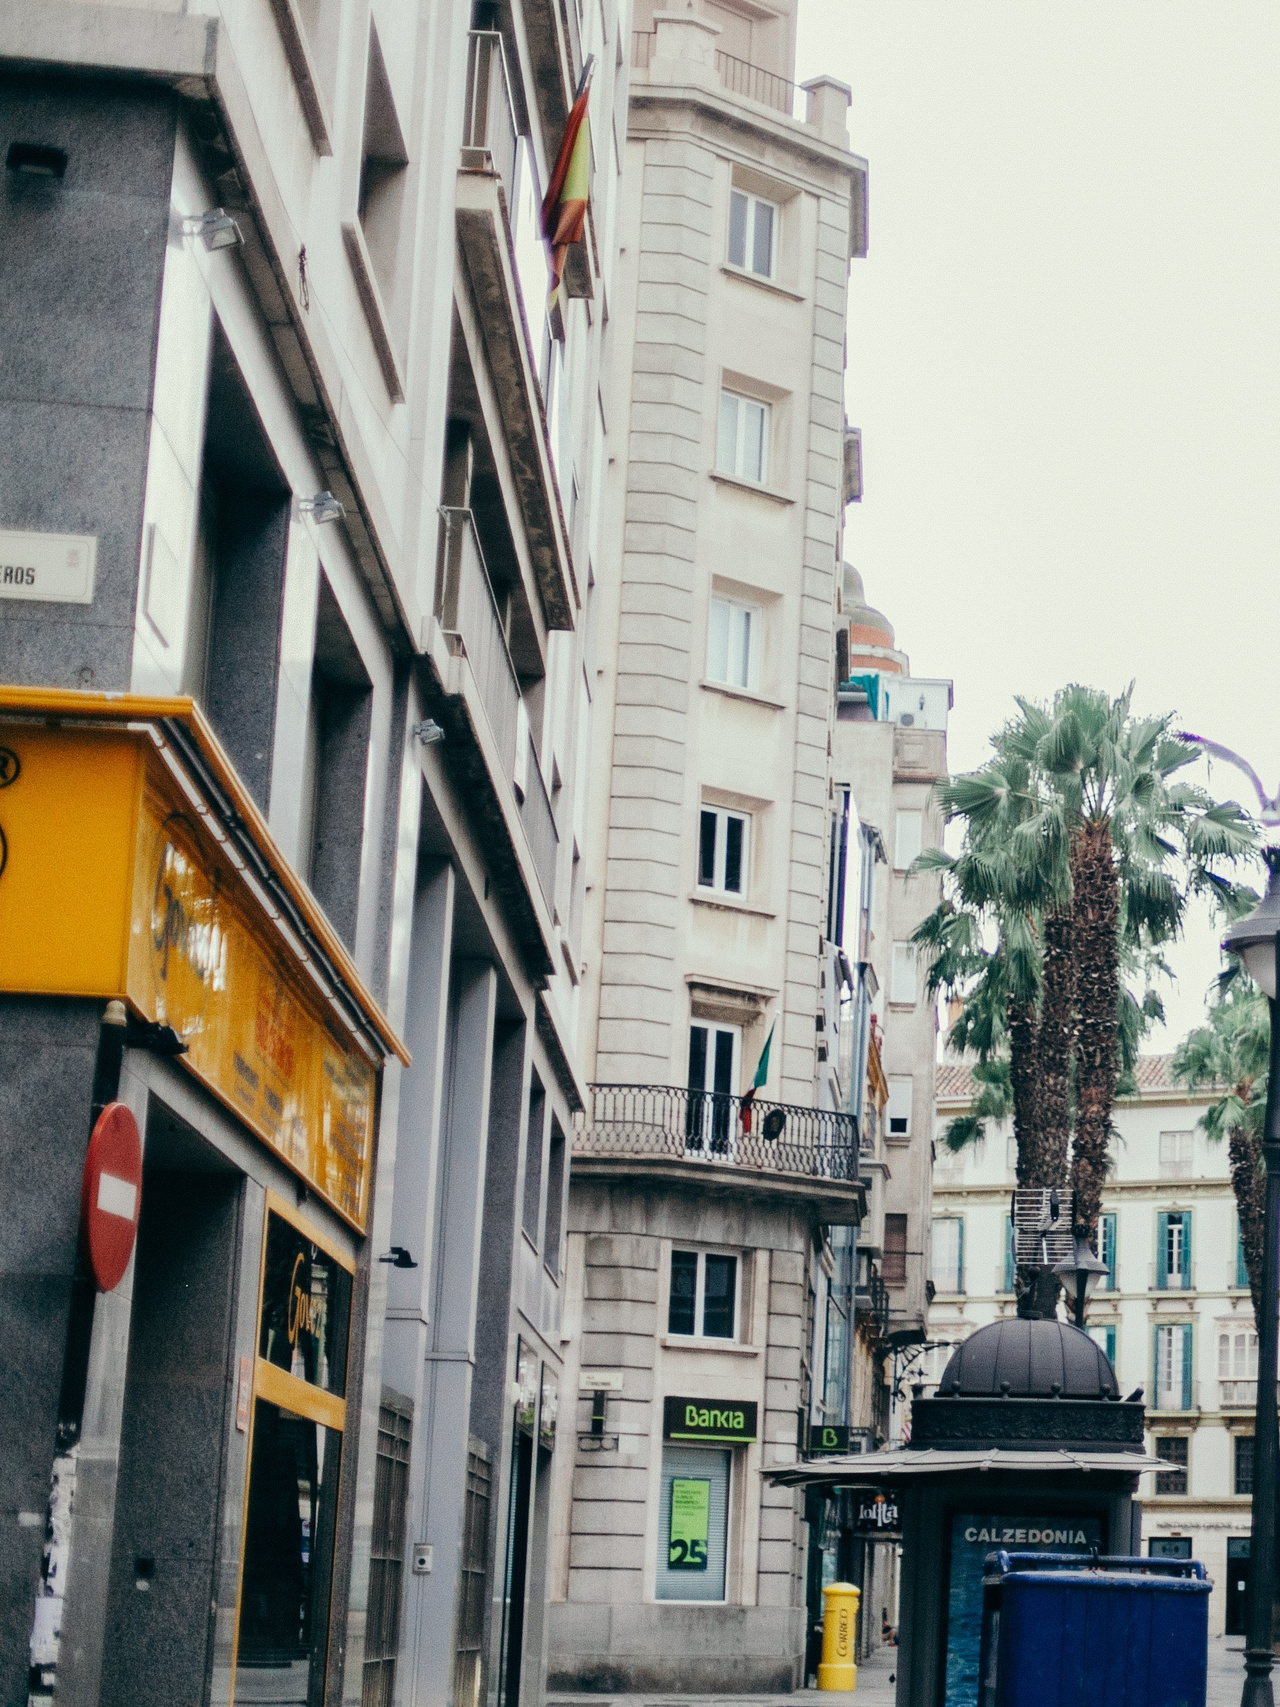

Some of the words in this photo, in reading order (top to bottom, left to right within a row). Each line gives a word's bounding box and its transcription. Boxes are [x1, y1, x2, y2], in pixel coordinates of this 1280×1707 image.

[0, 565, 36, 586] ROS
[685, 1405, 745, 1430] Bankia
[822, 1427, 839, 1447] B
[964, 1527, 1087, 1545] CALZEDONIA
